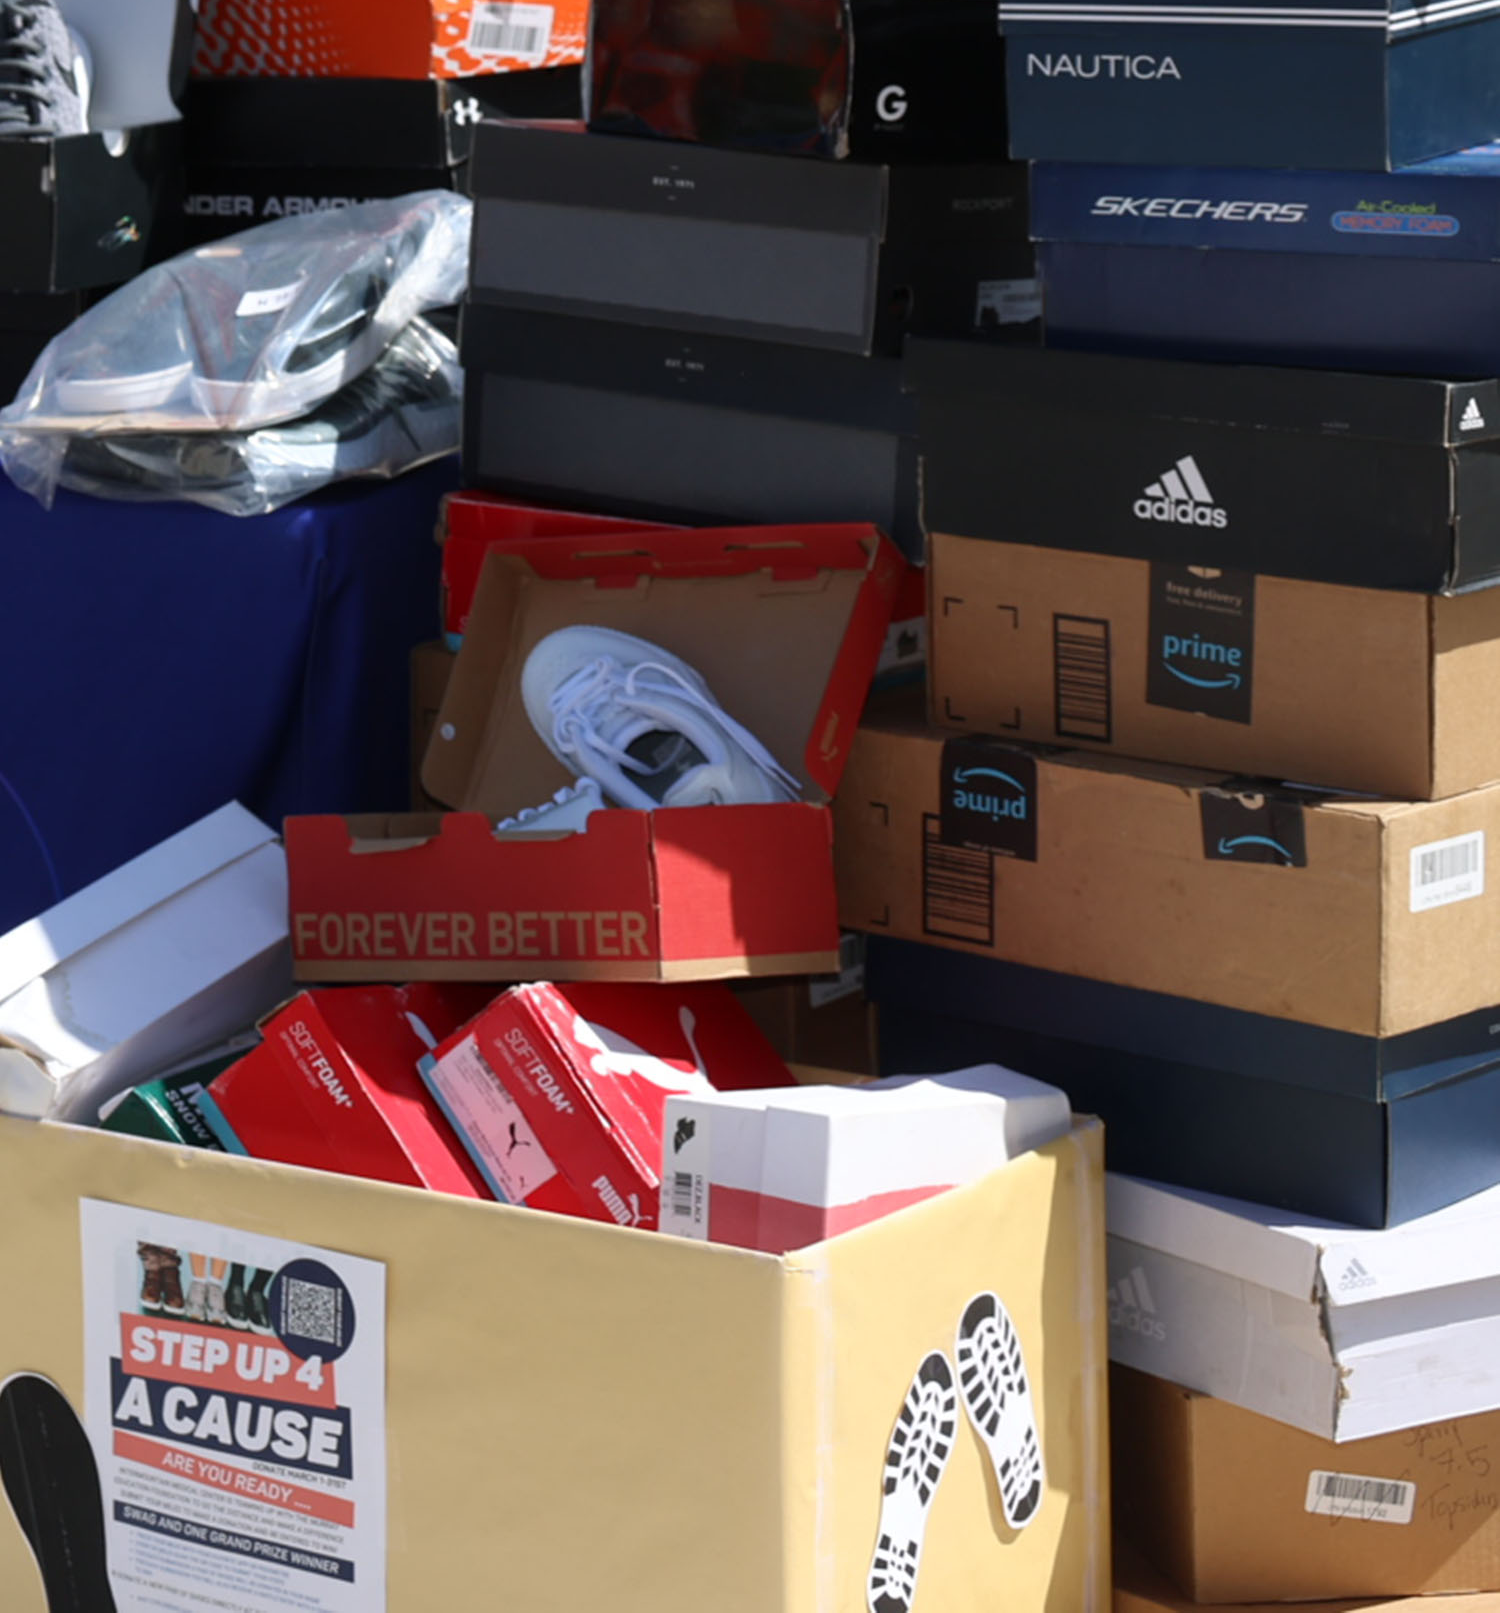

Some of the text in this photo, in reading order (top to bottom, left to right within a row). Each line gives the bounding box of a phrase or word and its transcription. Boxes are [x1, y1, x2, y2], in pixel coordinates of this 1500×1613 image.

[1027, 53, 1181, 79] NAUTICA
[876, 84, 908, 122] G
[184, 195, 253, 215] NDER
[1091, 195, 1308, 223] SKECHERS
[1133, 496, 1228, 528] adidas
[1163, 634, 1242, 667] prime
[953, 789, 1027, 822] prime
[295, 911, 650, 957] FOREVER BETTER
[165, 1090, 211, 1140] SNOW
[592, 1175, 632, 1226] PUMA
[1109, 1303, 1167, 1341] didas
[130, 1326, 324, 1391] STEP UP 4
[114, 1376, 344, 1469] A CAUSE
[162, 1451, 194, 1474] ARE
[197, 1461, 234, 1486] YOU
[234, 1473, 294, 1504] READY
[1430, 1444, 1489, 1476] 7.5
[124, 1505, 338, 1574] SWAG AND ONE GRAND PRIZE WINNER
